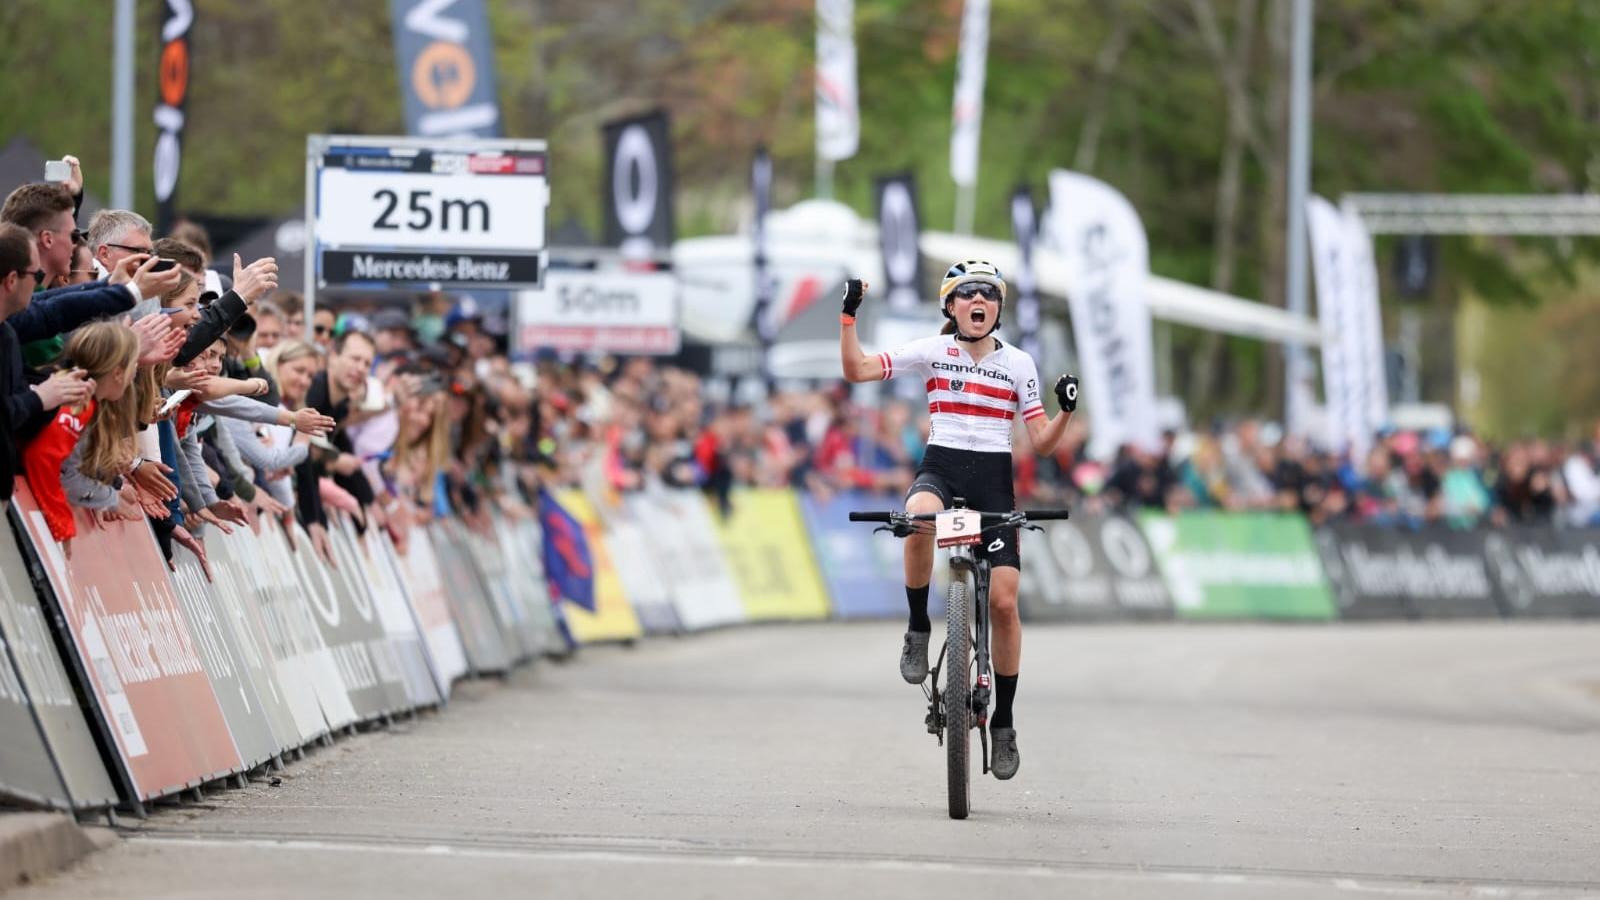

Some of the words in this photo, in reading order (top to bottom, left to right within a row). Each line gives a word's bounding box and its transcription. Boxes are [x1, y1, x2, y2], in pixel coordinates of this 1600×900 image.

[372, 188, 490, 232] 25m
[352, 255, 511, 281] Mercedes-Benz
[931, 361, 1015, 386] cannondale
[952, 516, 966, 531] 5
